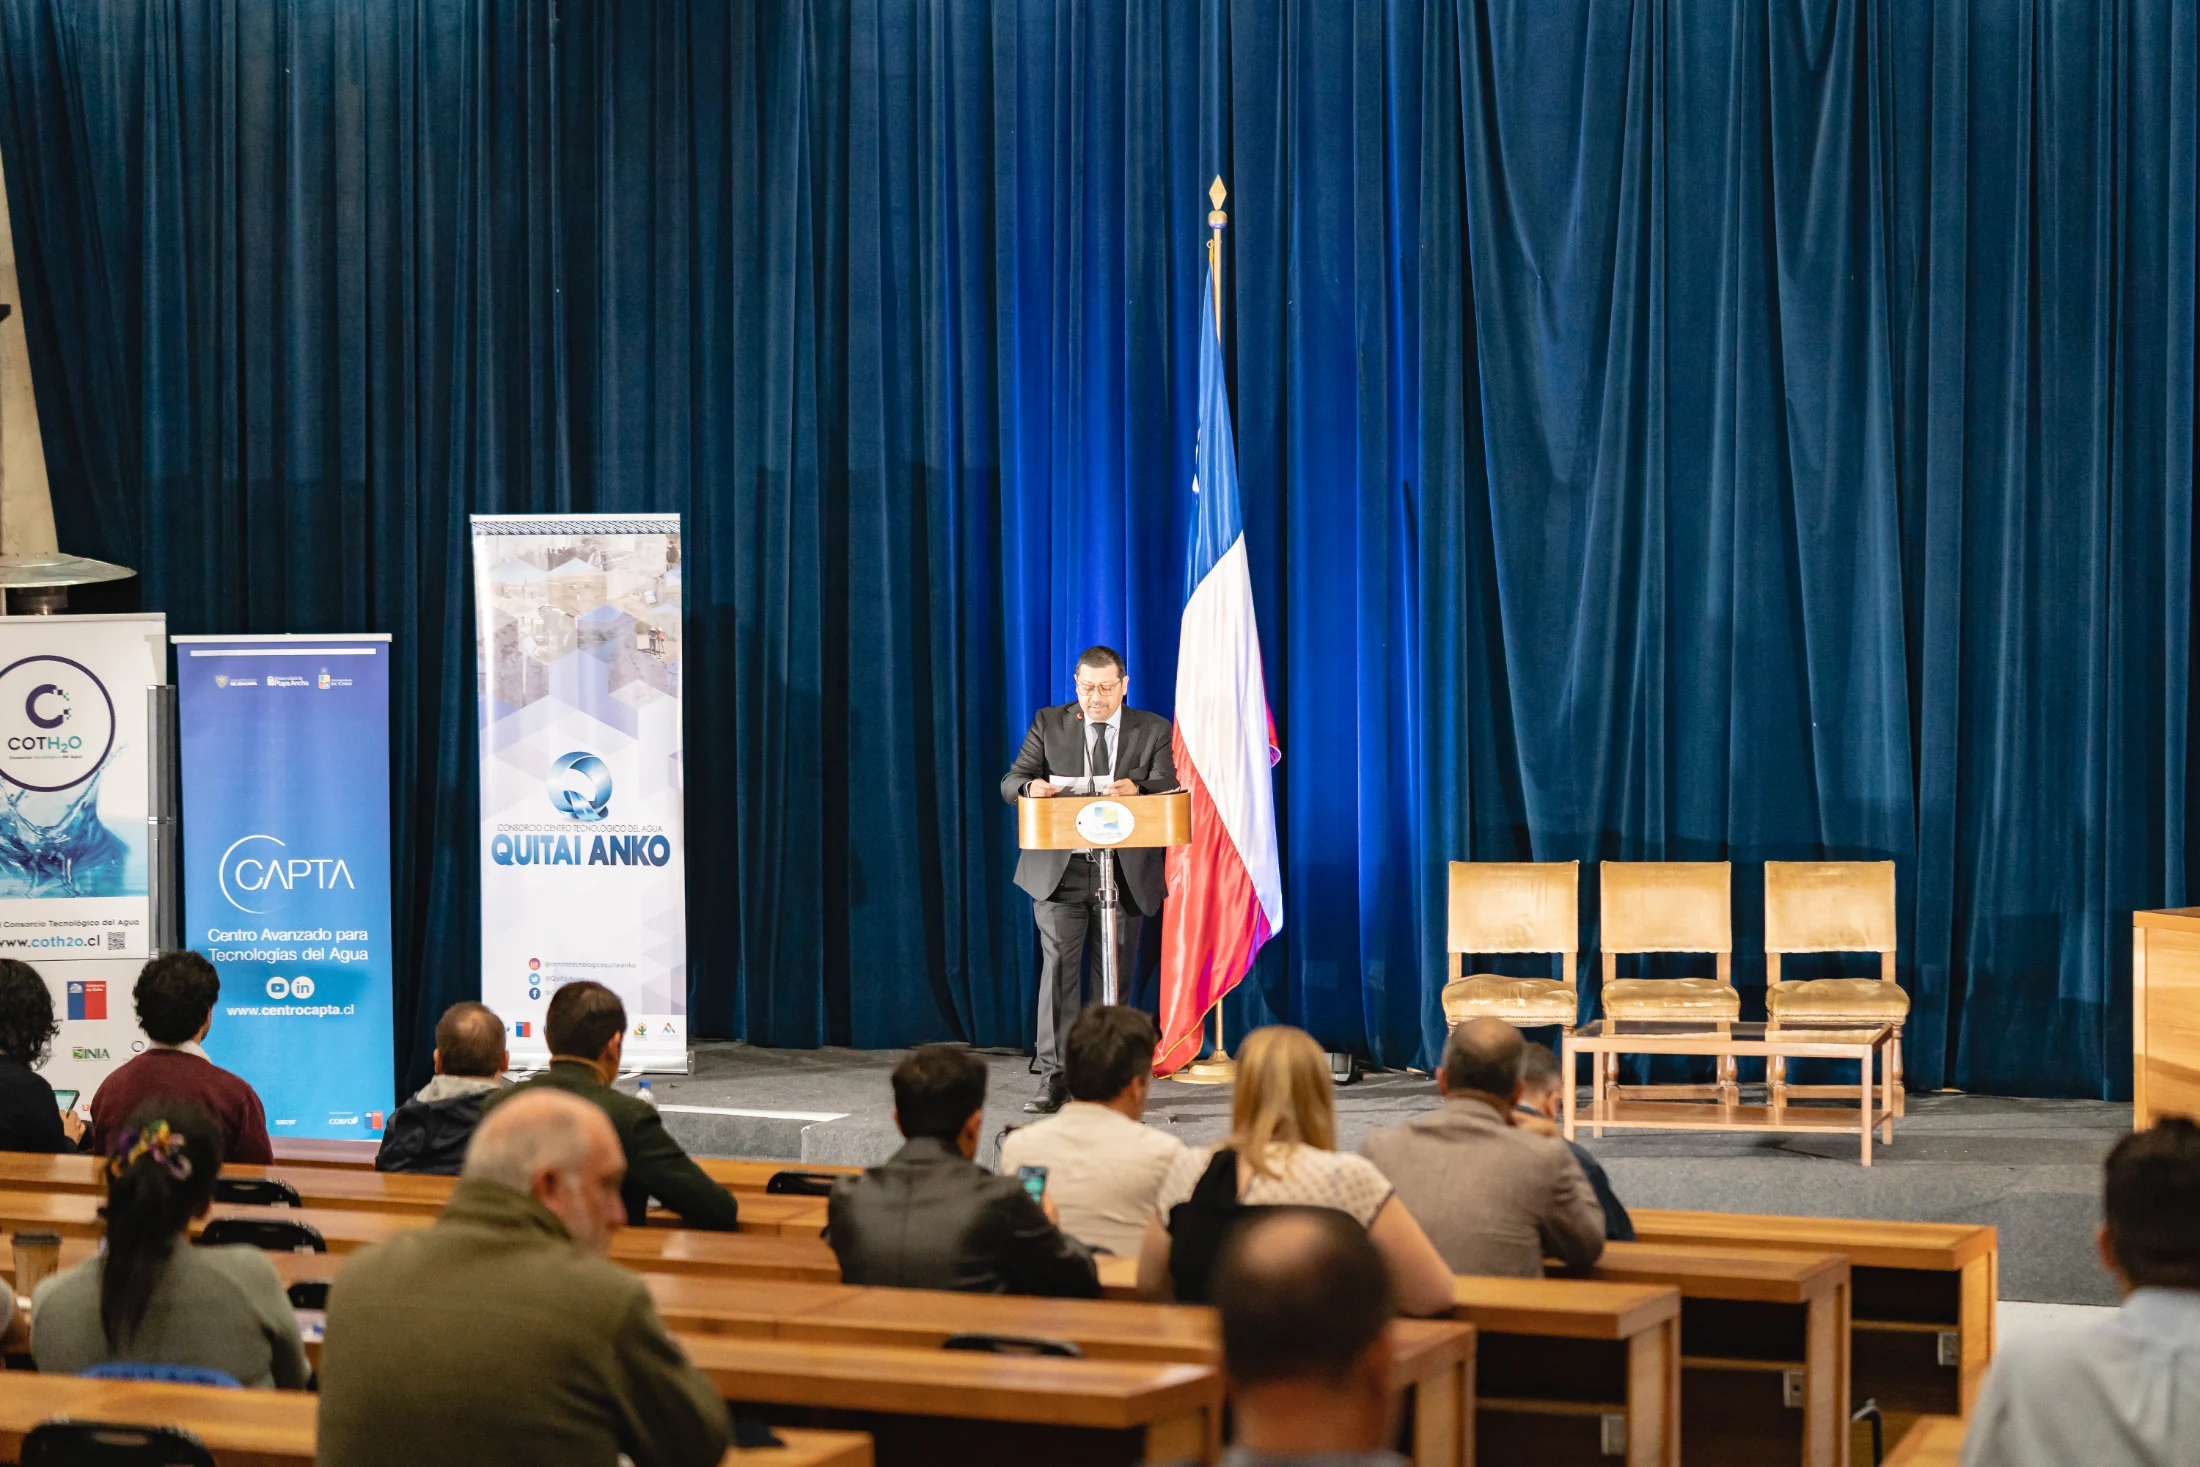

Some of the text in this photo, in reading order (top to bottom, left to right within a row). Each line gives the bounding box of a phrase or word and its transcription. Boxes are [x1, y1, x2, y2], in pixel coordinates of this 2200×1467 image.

[497, 824, 542, 832] CONSORCIO
[544, 824, 572, 832] CENTRO
[628, 824, 640, 832] DEL
[641, 824, 663, 833] AGUA
[491, 833, 671, 867] QUITAI ANKO
[235, 859, 355, 891] CAPTA
[117, 919, 140, 927] Agua
[208, 928, 368, 943] Centro Avanzado para
[208, 947, 368, 963] Tecnologías del Agua
[226, 1004, 354, 1018] www.centrocapta.cl
[84, 1048, 110, 1059] INIA
